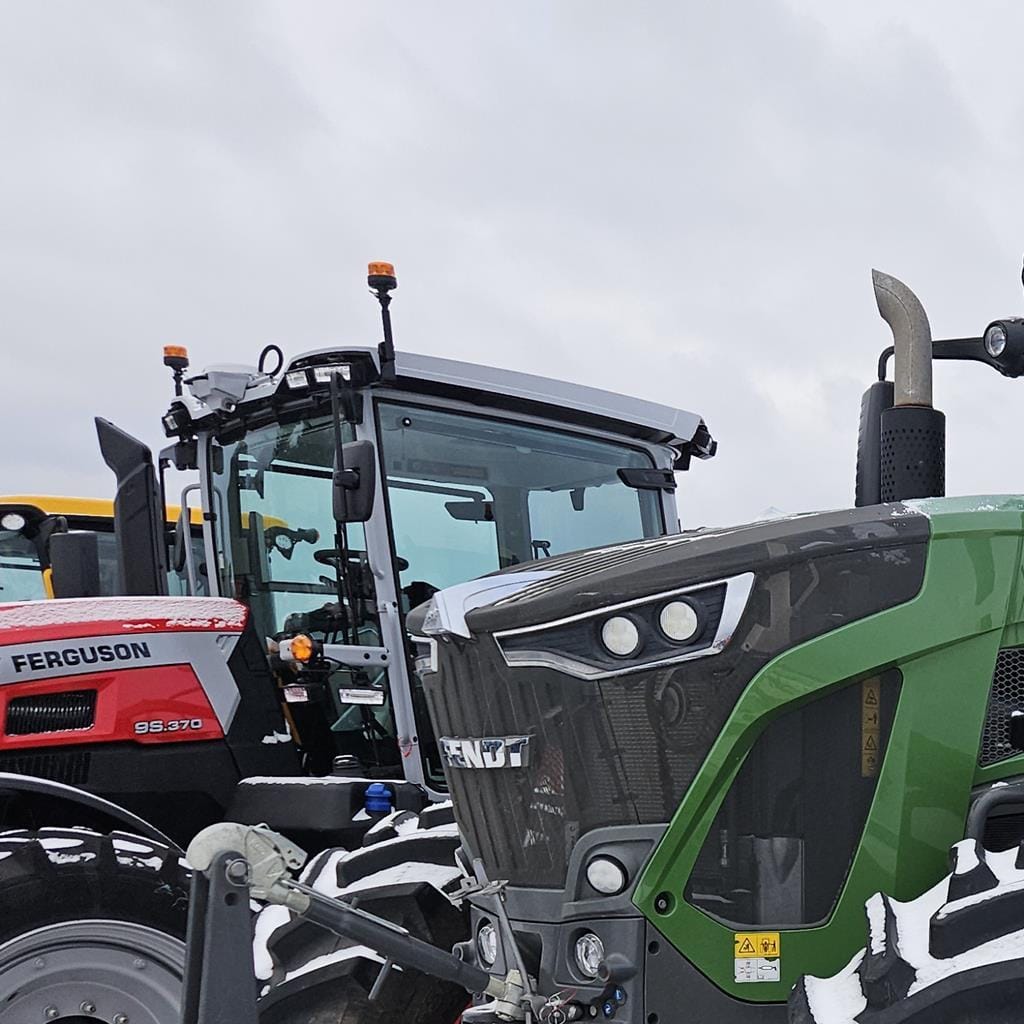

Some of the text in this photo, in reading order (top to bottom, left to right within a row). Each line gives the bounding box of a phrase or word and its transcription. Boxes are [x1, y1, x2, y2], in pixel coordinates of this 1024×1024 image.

[11, 641, 152, 674] FERGUSON
[134, 718, 203, 735] 9S.370
[440, 736, 530, 768] FENDT
